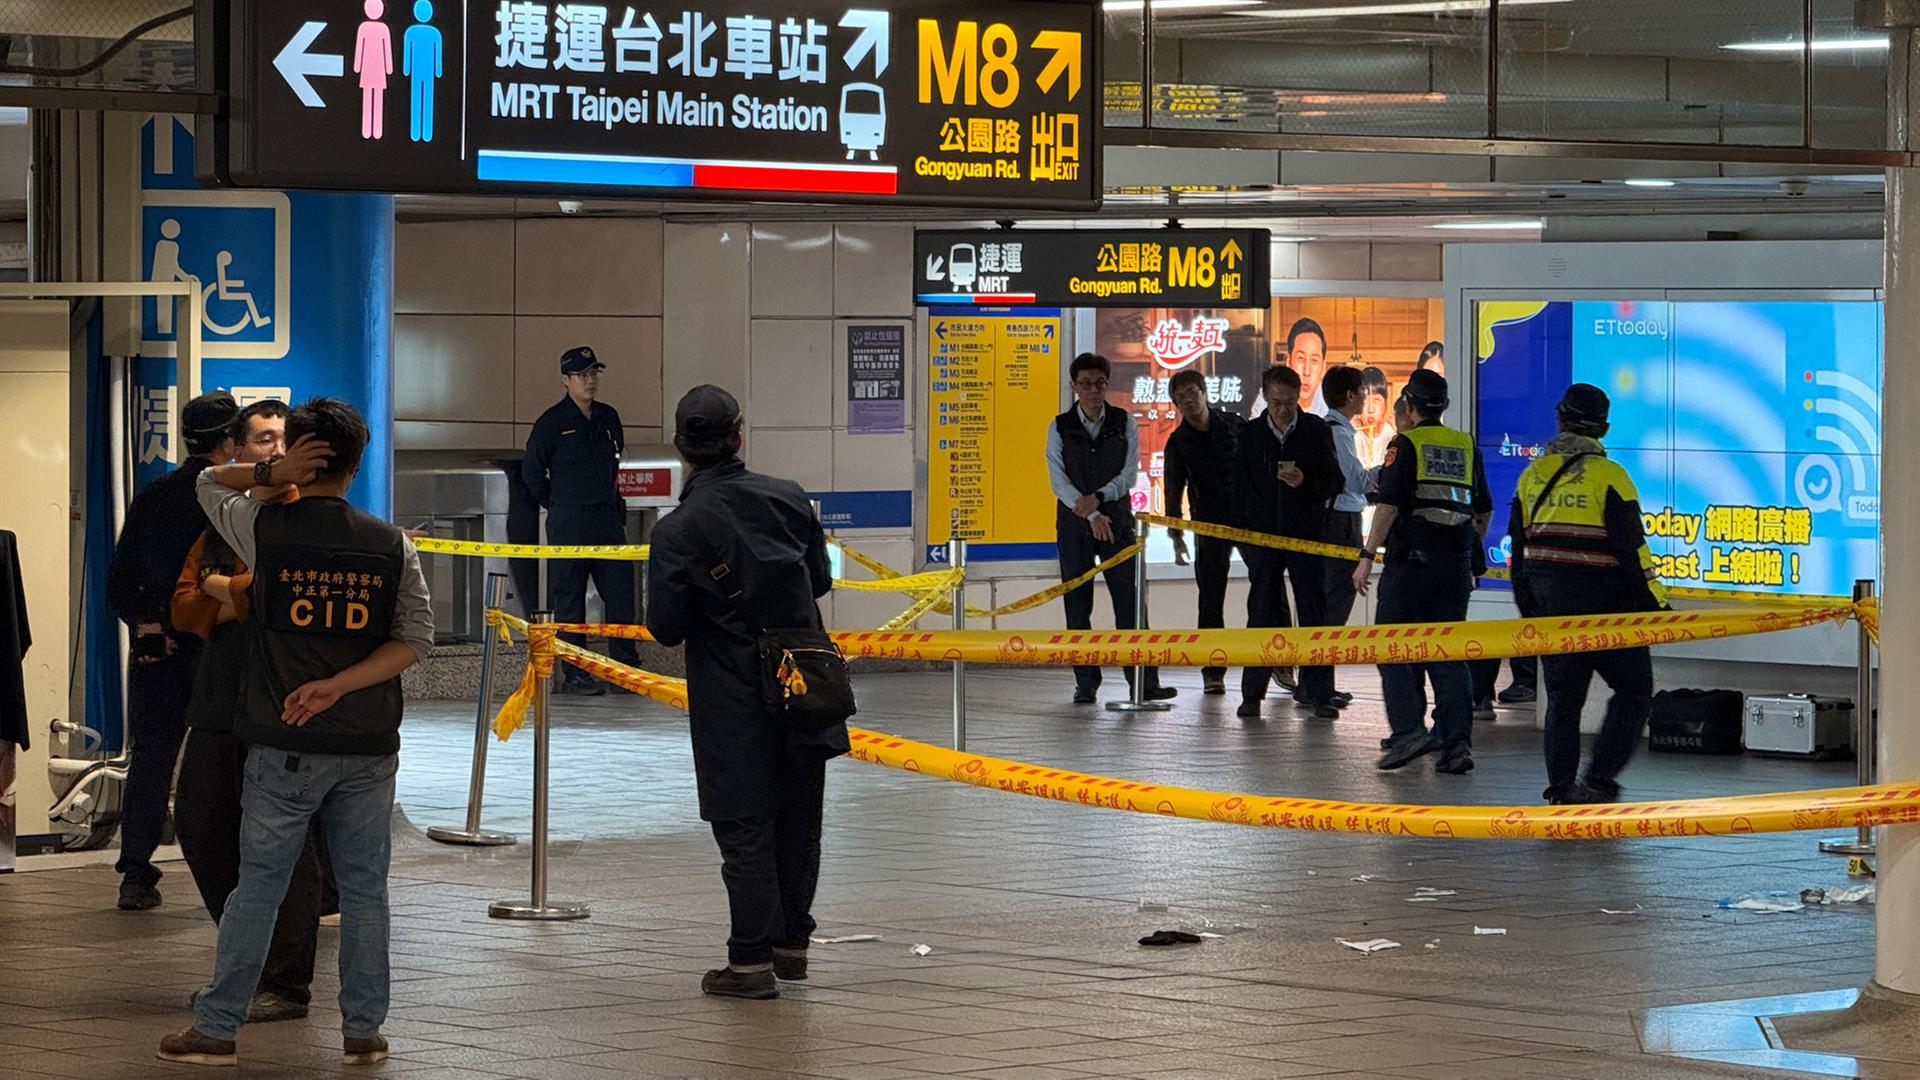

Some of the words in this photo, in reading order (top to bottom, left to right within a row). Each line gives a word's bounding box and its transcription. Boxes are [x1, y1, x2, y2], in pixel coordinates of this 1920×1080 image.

[495, 1, 828, 84] 捷運台北車站
[918, 18, 1020, 108] M8
[491, 82, 560, 119] MRT
[566, 86, 649, 130] Taipei
[657, 90, 724, 128] Main
[731, 93, 828, 132] Station
[939, 117, 1021, 154] 公園路
[1030, 111, 1079, 182] 出口
[915, 156, 993, 181] Gongyuan
[996, 160, 1021, 179] Rd.
[1055, 162, 1079, 181] EXIT
[980, 242, 1023, 274] 捷運
[1096, 243, 1163, 273] 公園路
[1168, 246, 1216, 288] M8
[978, 276, 1010, 293] MRT
[1069, 277, 1137, 297] Gongyuan
[1139, 278, 1163, 294] Rd.
[1594, 318, 1669, 341] ETtoday
[1132, 376, 1243, 404] 熟悉美味
[1427, 460, 1465, 478] POLICE
[1528, 494, 1587, 508] PLICE
[1642, 506, 1701, 544] oday
[1705, 504, 1812, 545] 網路廣播
[279, 568, 383, 588] 臺北市政府警察局
[1651, 550, 1700, 579] cast
[292, 584, 370, 601] 中正第一分局
[290, 599, 369, 630] CID
[1307, 645, 1379, 665] 刑案現場
[1386, 641, 1450, 664] 禁止進入
